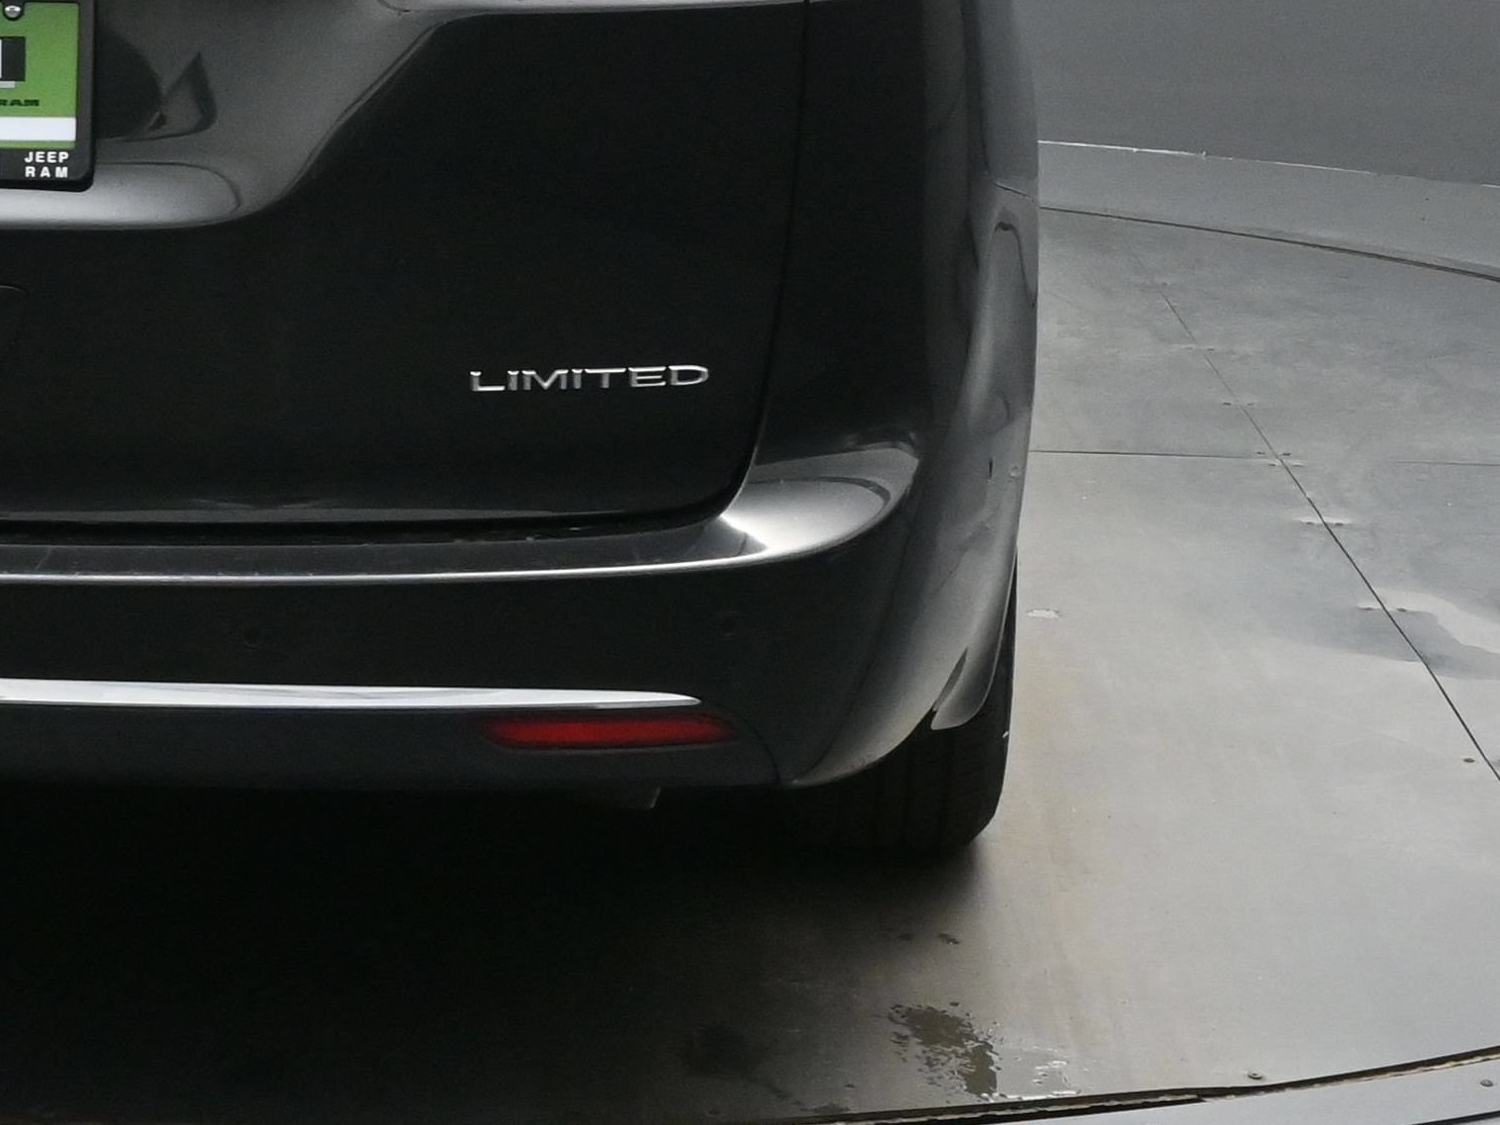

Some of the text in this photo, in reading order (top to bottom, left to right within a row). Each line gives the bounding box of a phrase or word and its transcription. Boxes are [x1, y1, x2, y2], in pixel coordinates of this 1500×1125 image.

[24, 151, 69, 163] JEEP
[24, 165, 69, 179] RAM
[469, 365, 710, 392] LIMITED
